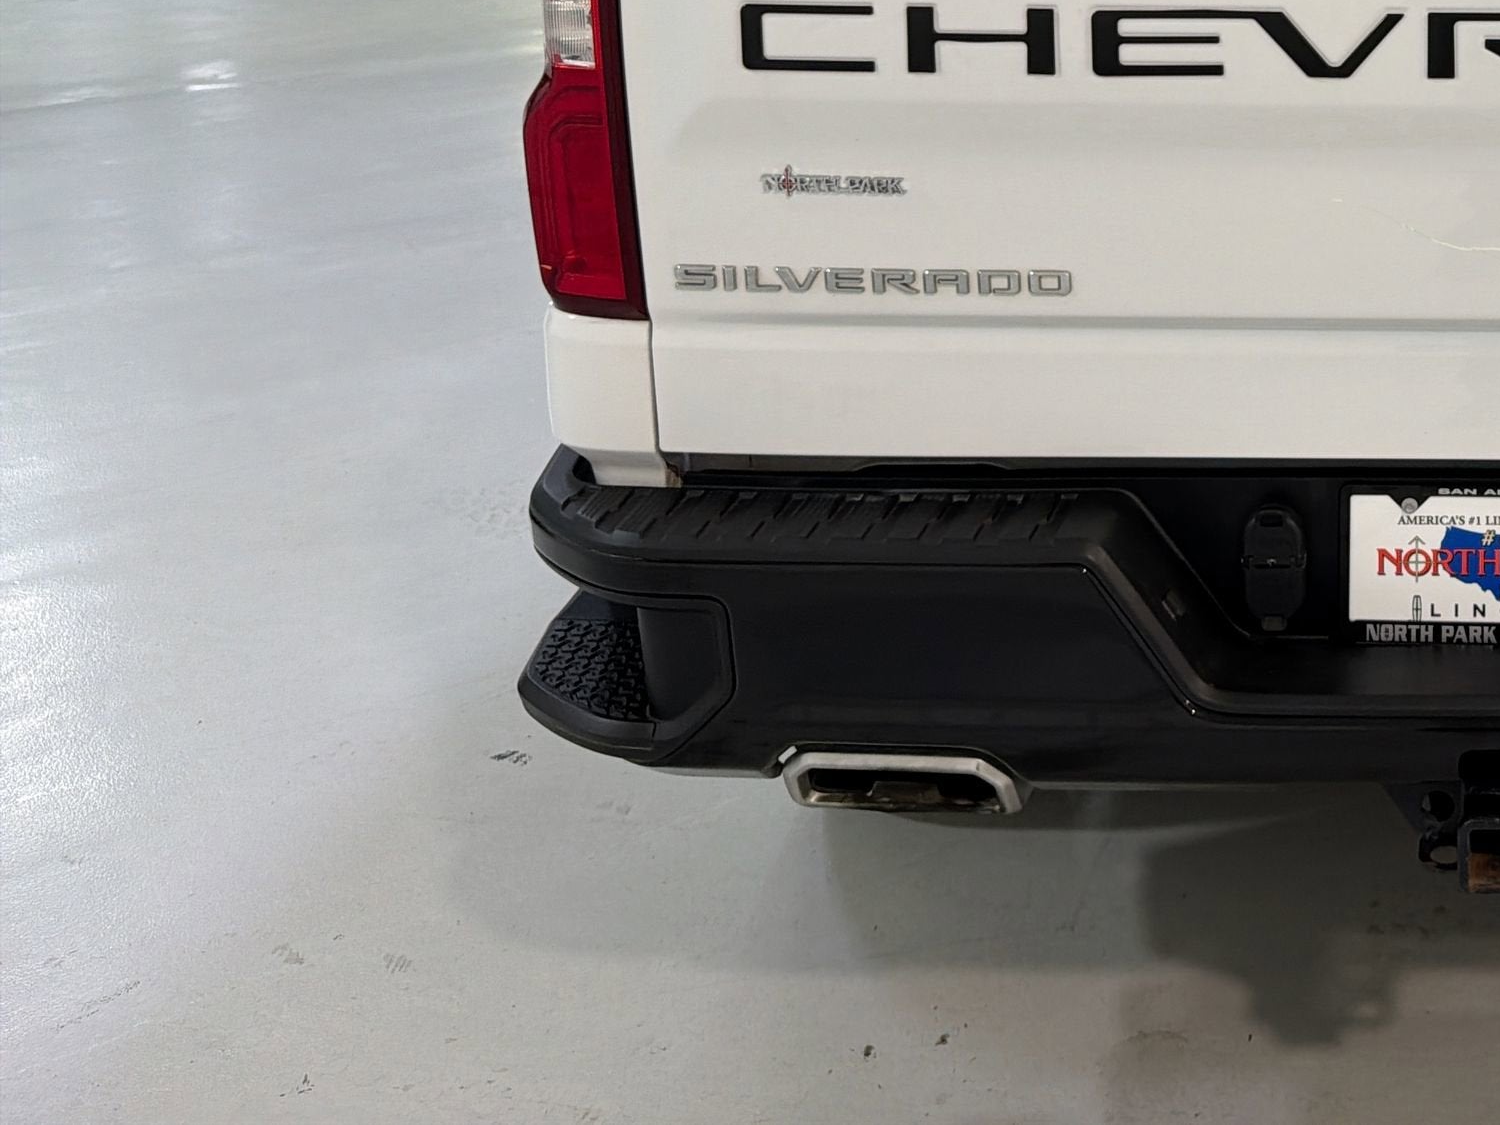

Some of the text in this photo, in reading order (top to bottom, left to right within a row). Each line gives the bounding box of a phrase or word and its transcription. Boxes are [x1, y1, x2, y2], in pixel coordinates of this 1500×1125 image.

[761, 172, 907, 195] NORTH PARK
[674, 263, 1073, 297] SILVERADO
[1398, 515, 1465, 526] AMERICA'S
[1468, 516, 1481, 526] #1
[1366, 623, 1434, 642] NORTH
[1441, 625, 1497, 644] PARK
